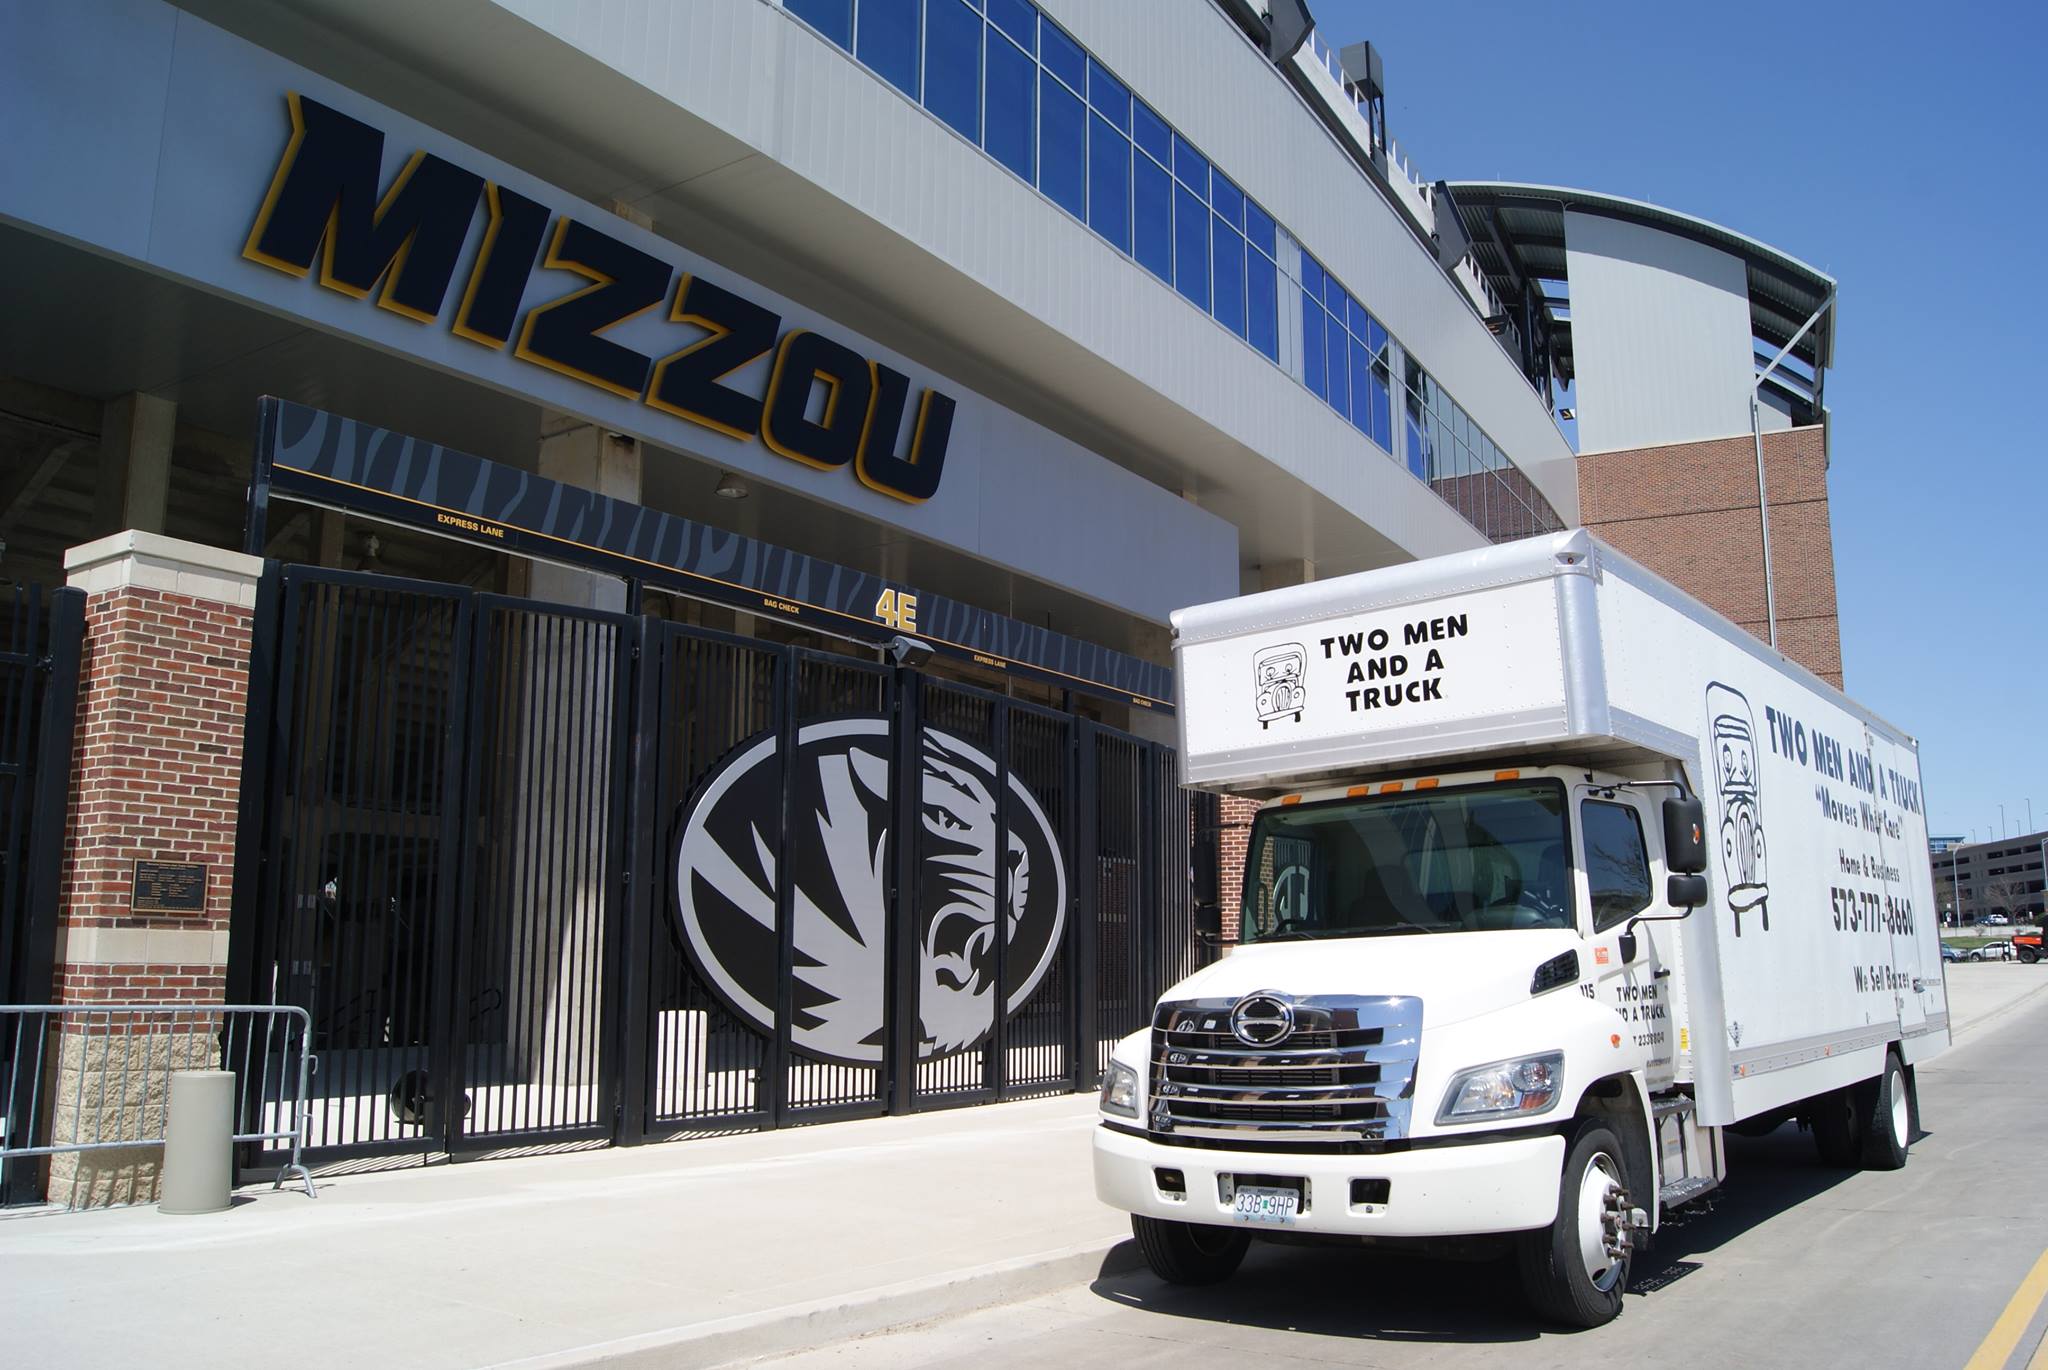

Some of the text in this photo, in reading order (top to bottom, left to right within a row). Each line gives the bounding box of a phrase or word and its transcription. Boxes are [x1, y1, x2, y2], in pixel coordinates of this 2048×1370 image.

[242, 91, 956, 505] MIZZOU
[437, 513, 504, 538] EXPRESS LANE
[763, 598, 800, 614] BAG CHECK
[875, 588, 917, 632] 4E
[1320, 613, 1469, 659] TWO MEN
[1346, 648, 1444, 684] AND A
[1345, 677, 1443, 712] TRUCK
[1765, 705, 1921, 816] TWO MEN AND A TRUCK
[1839, 848, 1861, 876] Home
[1862, 853, 1869, 878] &
[1830, 886, 1914, 936] 573-777-8660
[1580, 983, 1595, 999] 115
[1616, 984, 1658, 1002] TWO MEN
[1853, 965, 1910, 993] We Sell Boxes
[1632, 1007, 1639, 1022] A
[1640, 1003, 1667, 1020] TRUCK
